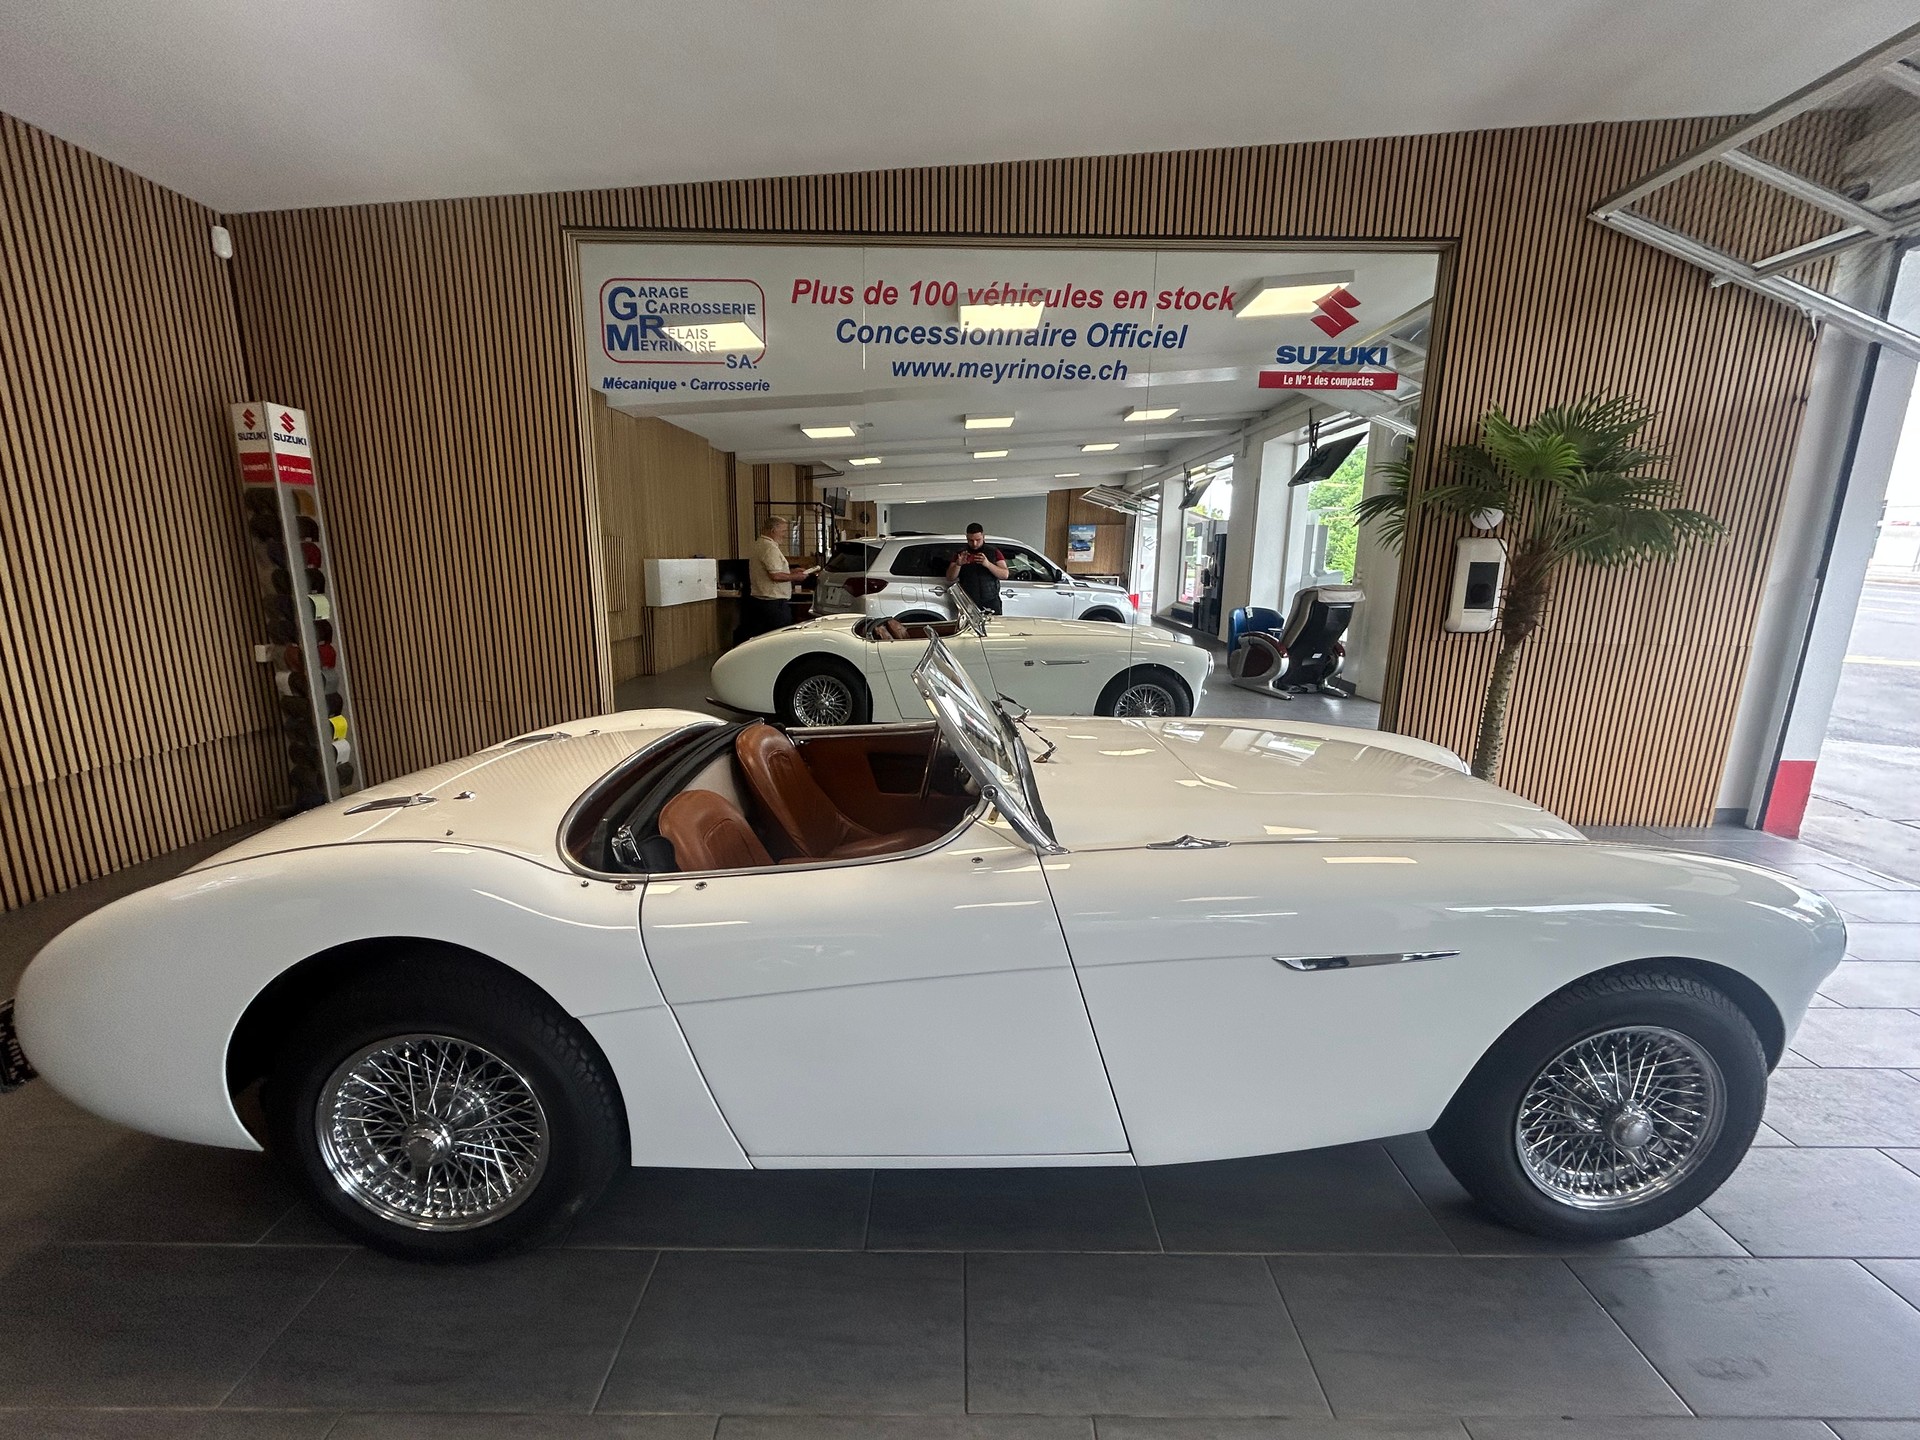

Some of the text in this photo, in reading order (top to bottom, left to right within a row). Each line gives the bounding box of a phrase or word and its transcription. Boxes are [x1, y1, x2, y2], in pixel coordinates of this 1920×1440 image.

[791, 279, 1236, 310] Plus de 100 véhicules en stock
[645, 300, 756, 315] CARROSSERIE
[835, 318, 1188, 349] Concessionnaire Officiel
[726, 354, 757, 370] SA.
[1276, 345, 1388, 365] SUZUKI
[891, 358, 1128, 385] www.meyrinoise.ch
[602, 376, 770, 392] Mécanique Carrosserie
[1283, 374, 1293, 385] Le
[1314, 376, 1329, 387] des
[1330, 376, 1374, 388] compactes
[238, 431, 267, 440] SUZUKI
[273, 432, 307, 445] SUZUKI
